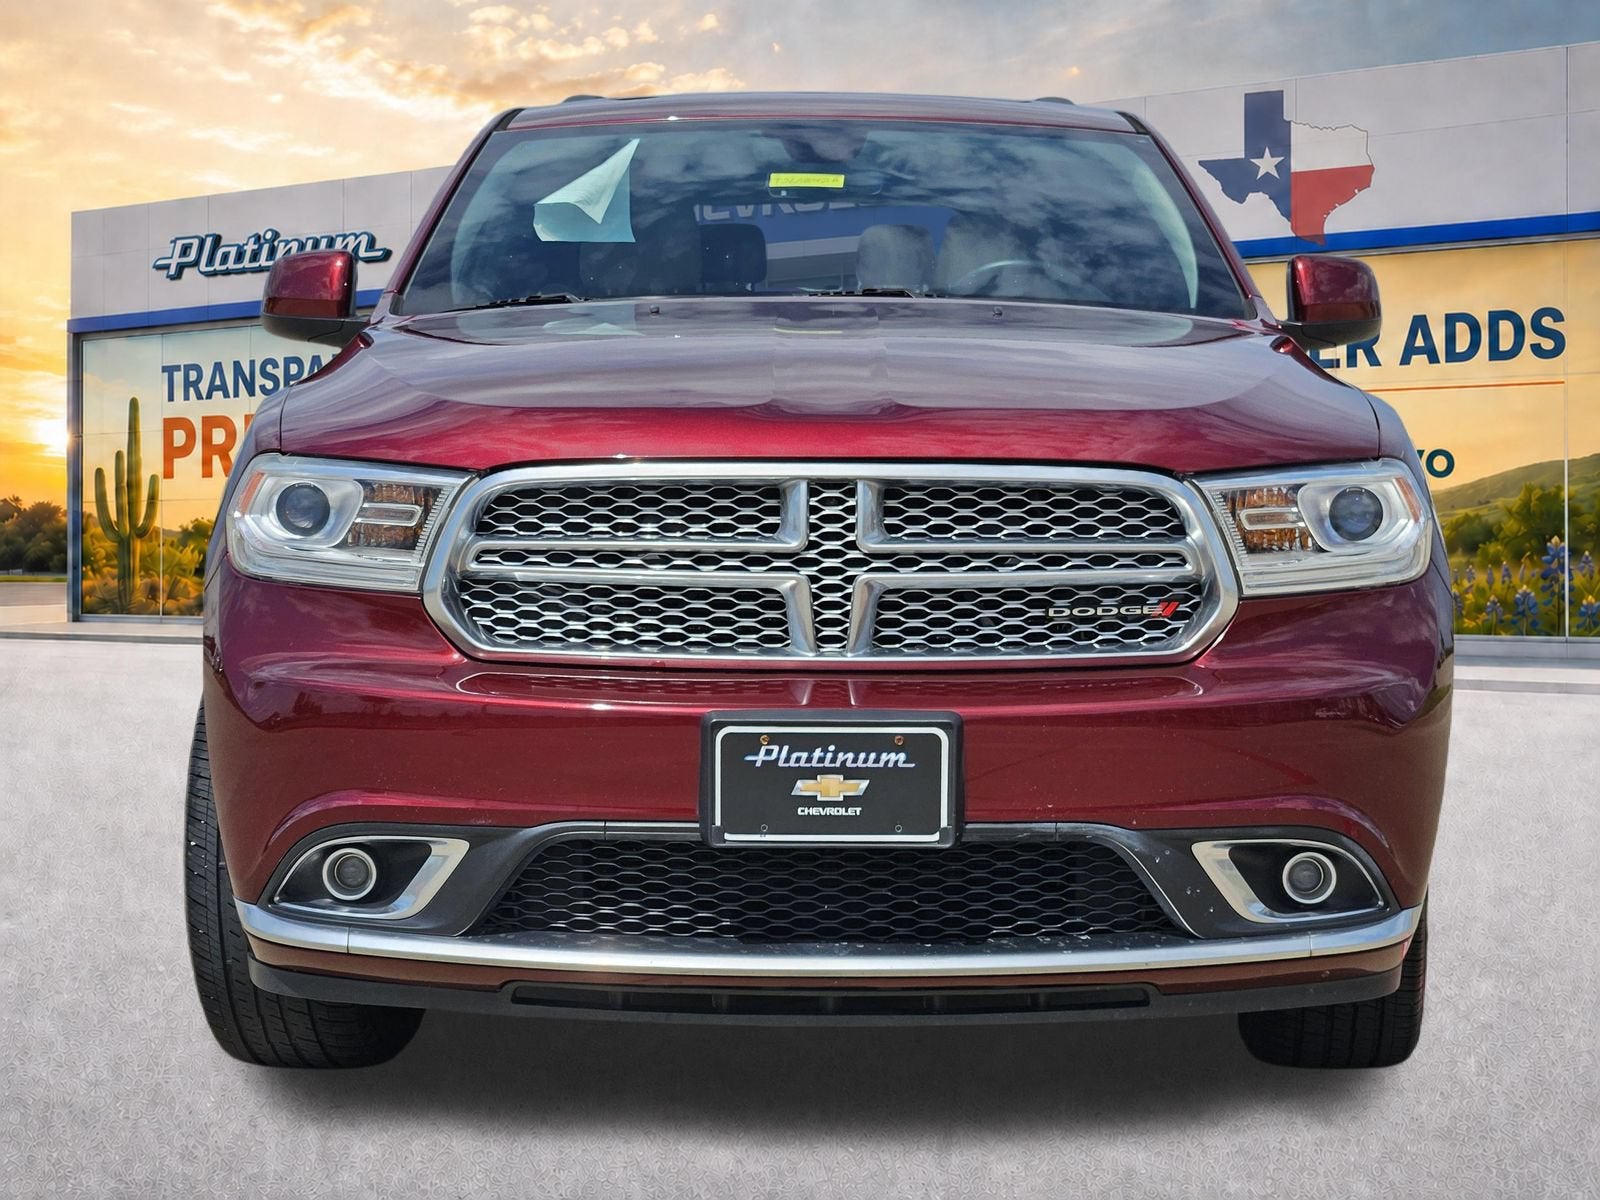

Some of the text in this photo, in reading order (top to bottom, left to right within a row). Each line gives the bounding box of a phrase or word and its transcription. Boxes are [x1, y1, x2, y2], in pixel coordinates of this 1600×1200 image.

[1399, 306, 1567, 366] ADDS
[161, 353, 337, 403] TRANSPA
[1048, 604, 1163, 617] DODGE
[744, 744, 916, 768] Platinum
[797, 806, 862, 817] CHEVROLET
